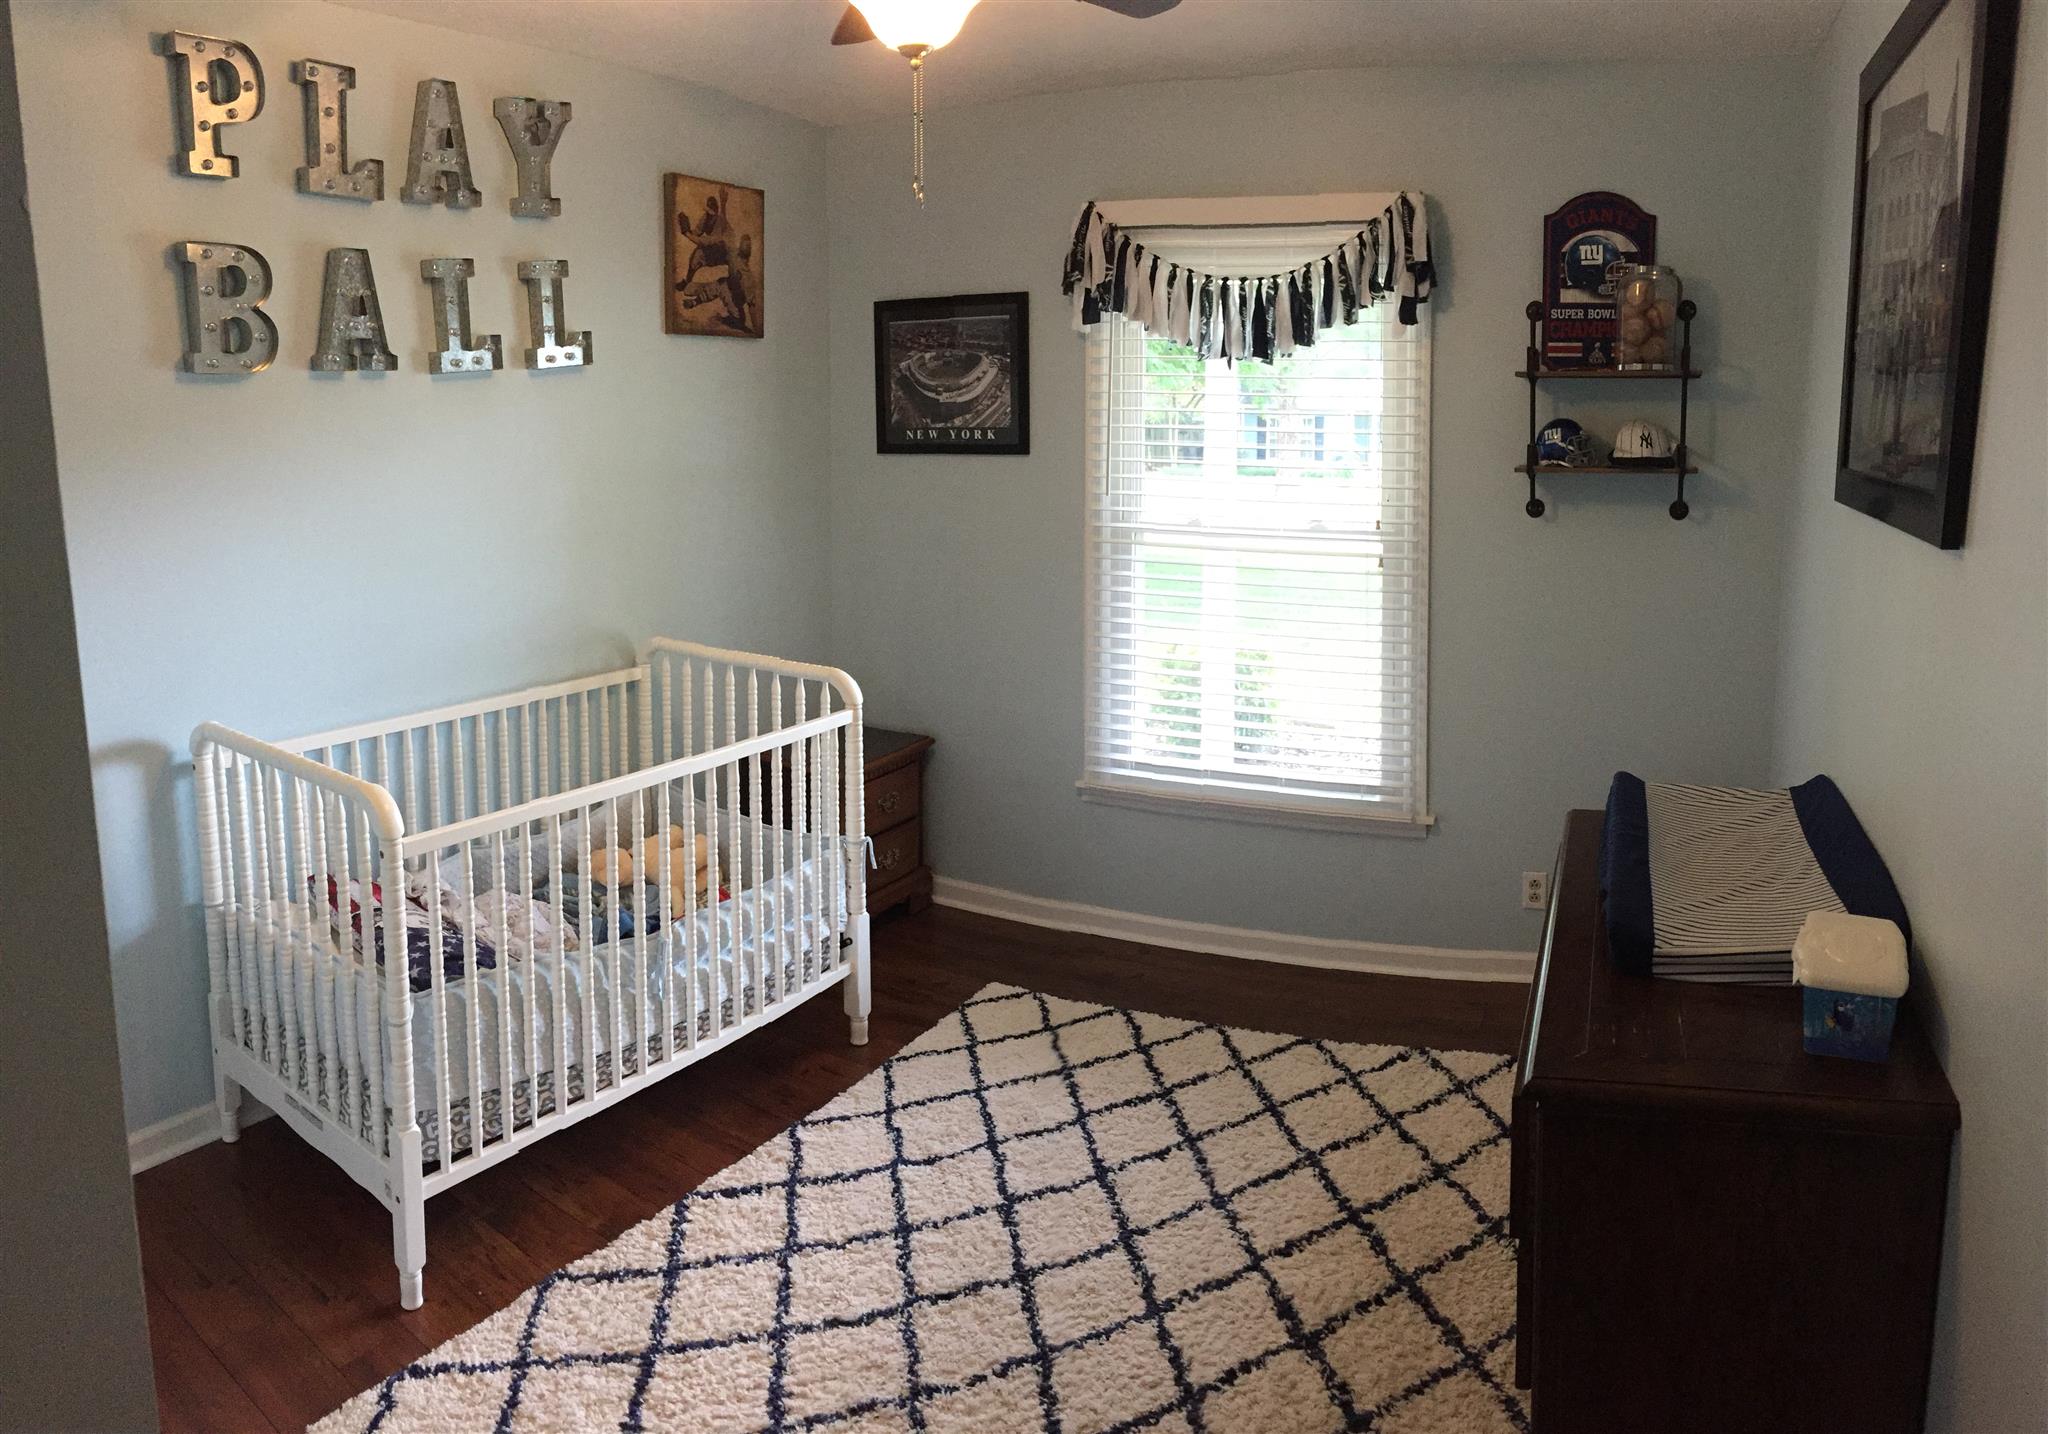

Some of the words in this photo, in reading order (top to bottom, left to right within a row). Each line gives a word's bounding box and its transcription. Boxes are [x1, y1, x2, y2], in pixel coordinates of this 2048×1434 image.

[168, 29, 572, 218] PLAY
[1567, 207, 1638, 230] GIANTS
[179, 241, 593, 374] BALL
[1551, 309, 1584, 319] SUPER
[1588, 309, 1617, 319] BOWL
[1551, 321, 1617, 337] CHAMPI
[906, 429, 939, 440] NEW
[949, 429, 997, 440] YORK
[1640, 432, 1653, 448] NY
